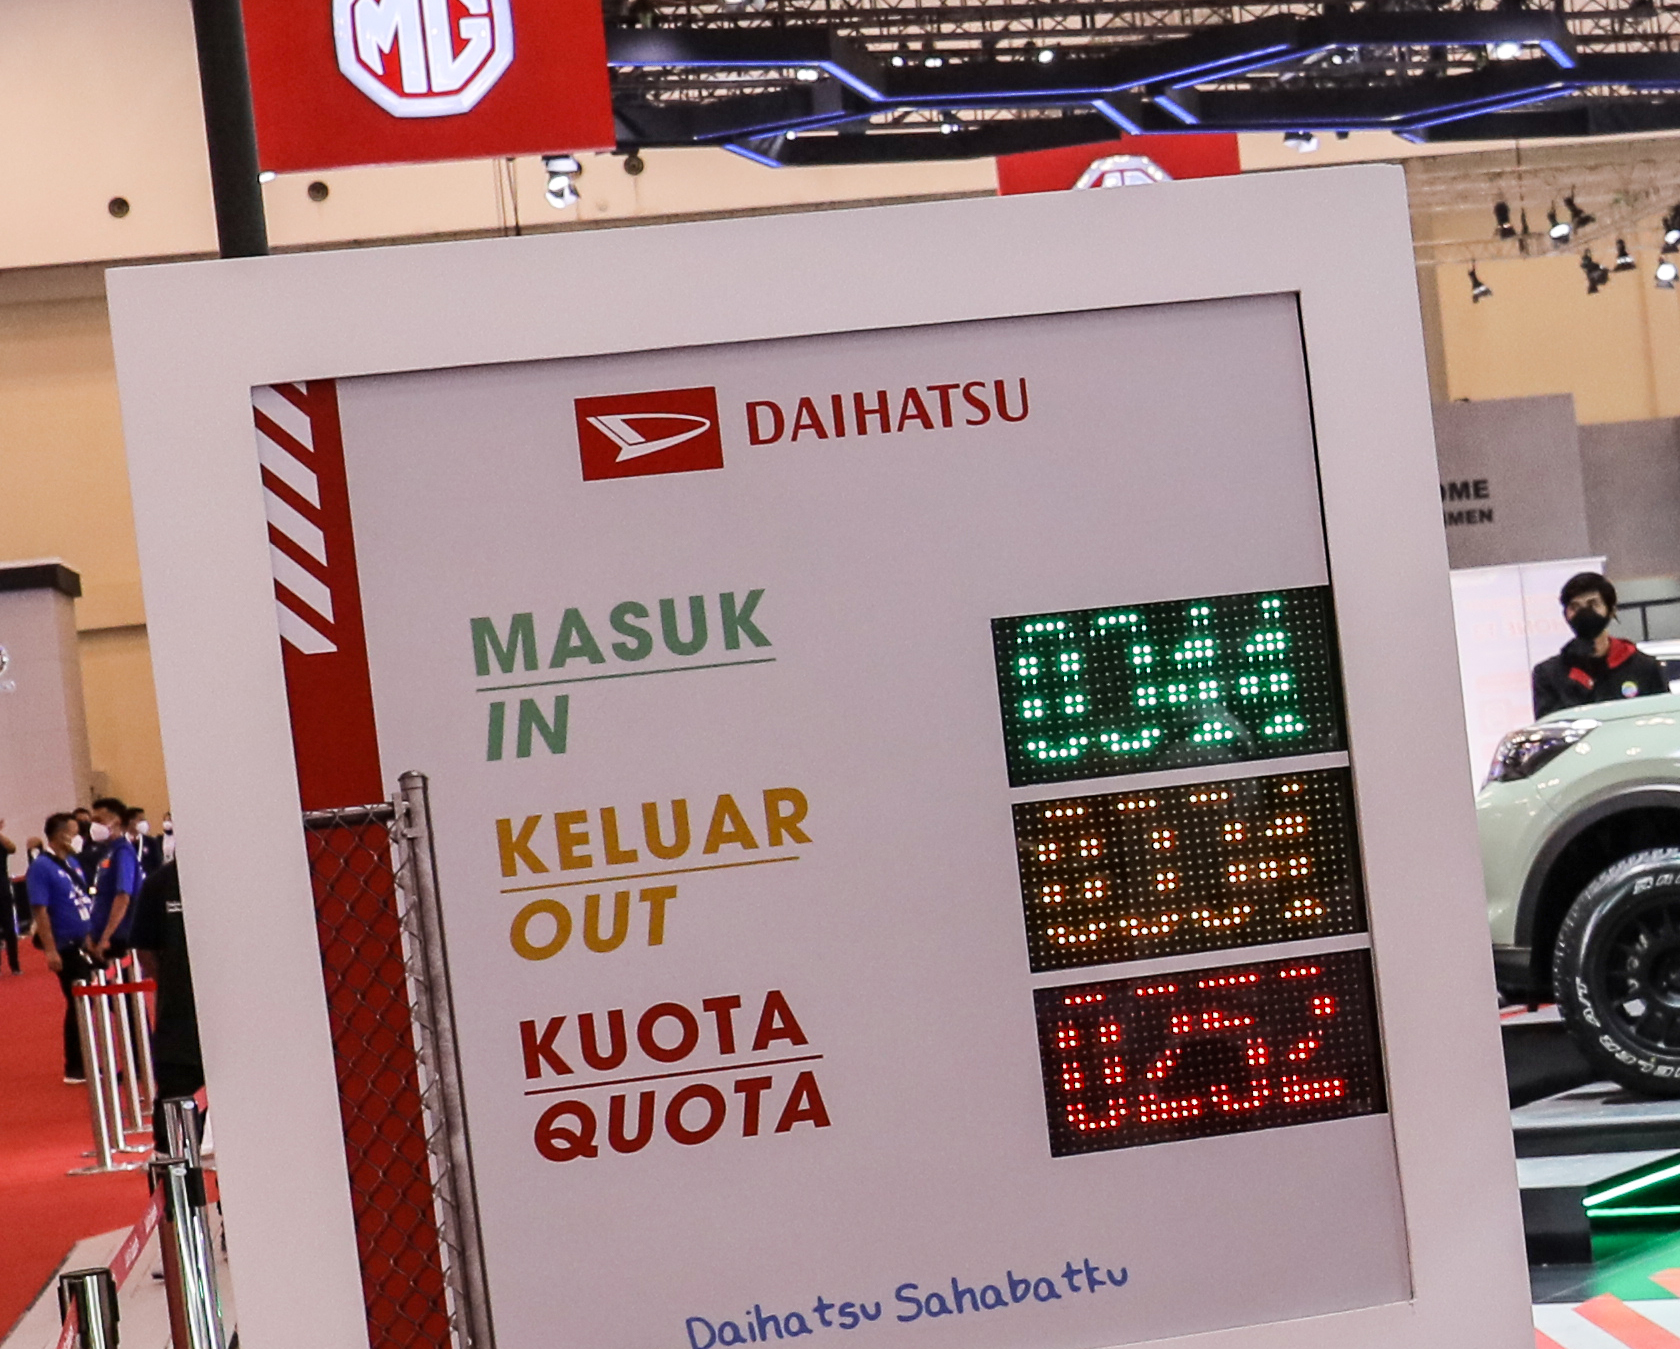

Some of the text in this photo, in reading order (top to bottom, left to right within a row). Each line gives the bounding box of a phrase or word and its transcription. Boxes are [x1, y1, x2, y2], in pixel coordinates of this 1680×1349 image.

[744, 377, 1031, 448] DAIHATSU
[1444, 509, 1494, 528] MEN
[469, 588, 774, 677] MASUK
[485, 695, 572, 763] IN
[493, 785, 814, 879] KELUAR
[508, 885, 679, 962] OUT
[518, 989, 811, 1079] KUOTA
[532, 1070, 833, 1163] QUOTA
[893, 1257, 1131, 1324] Sahabatku
